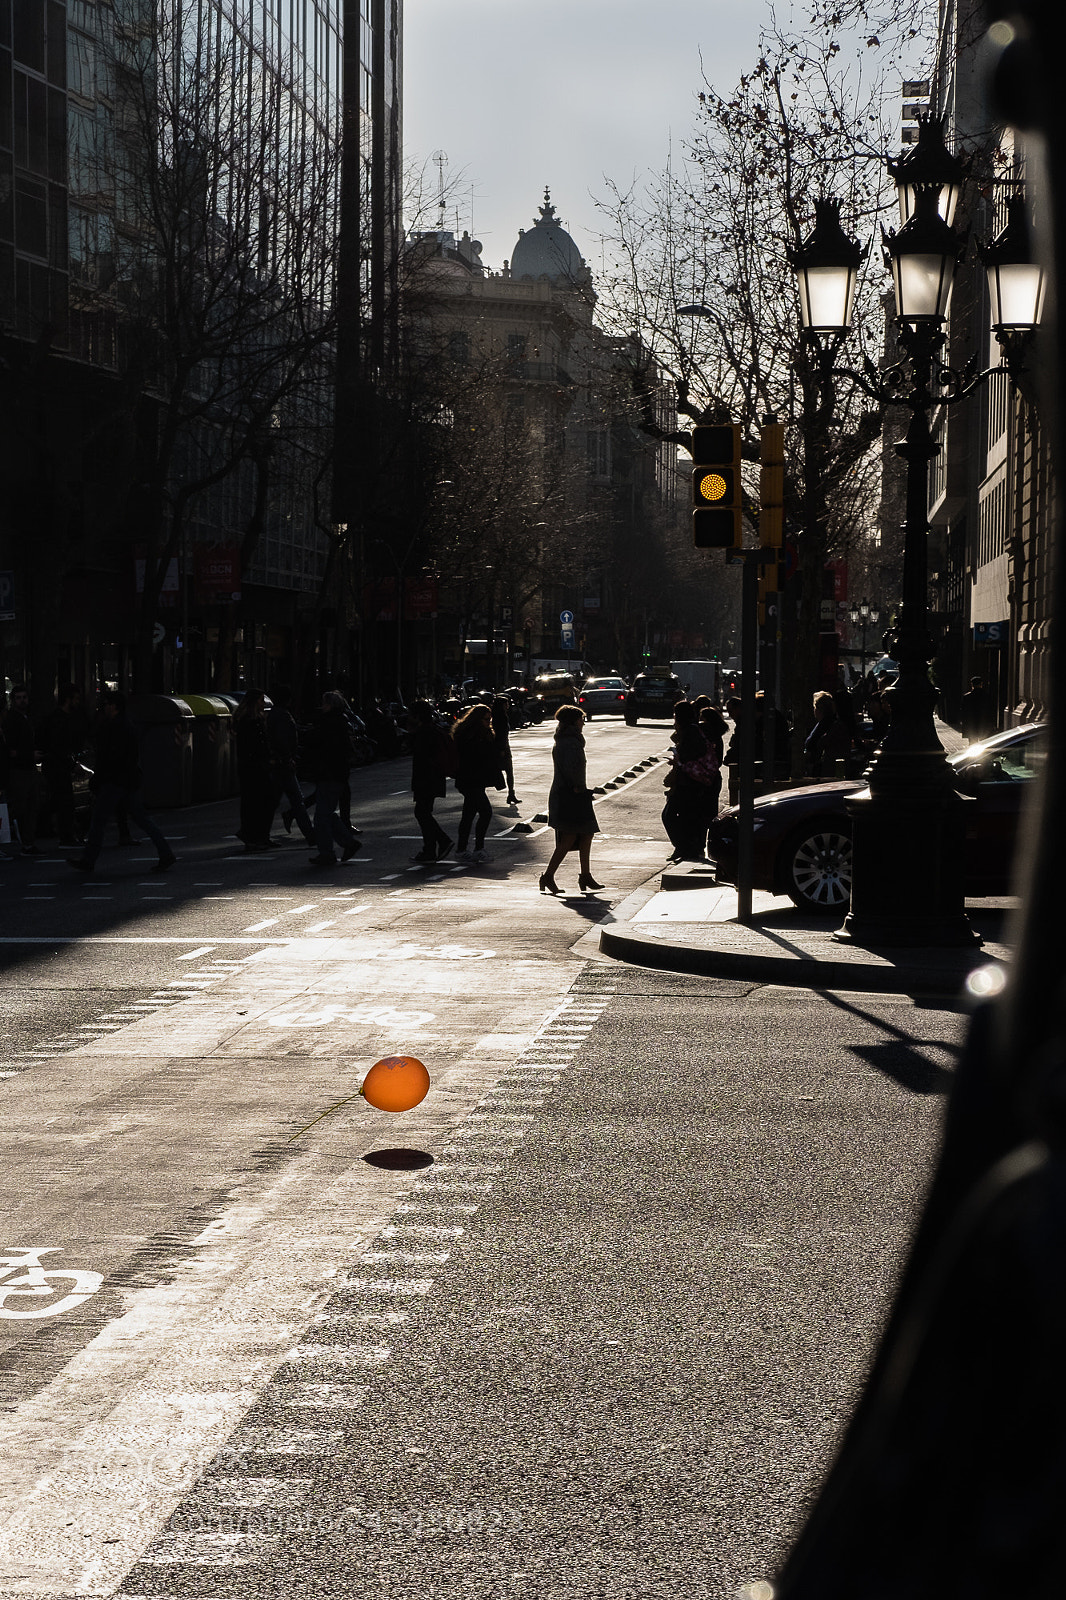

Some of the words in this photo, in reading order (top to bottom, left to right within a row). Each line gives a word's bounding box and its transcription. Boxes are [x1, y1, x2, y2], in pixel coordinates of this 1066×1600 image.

[0, 576, 10, 607] P
[502, 607, 512, 620] P
[563, 631, 572, 642] P
[988, 625, 1000, 640] S
